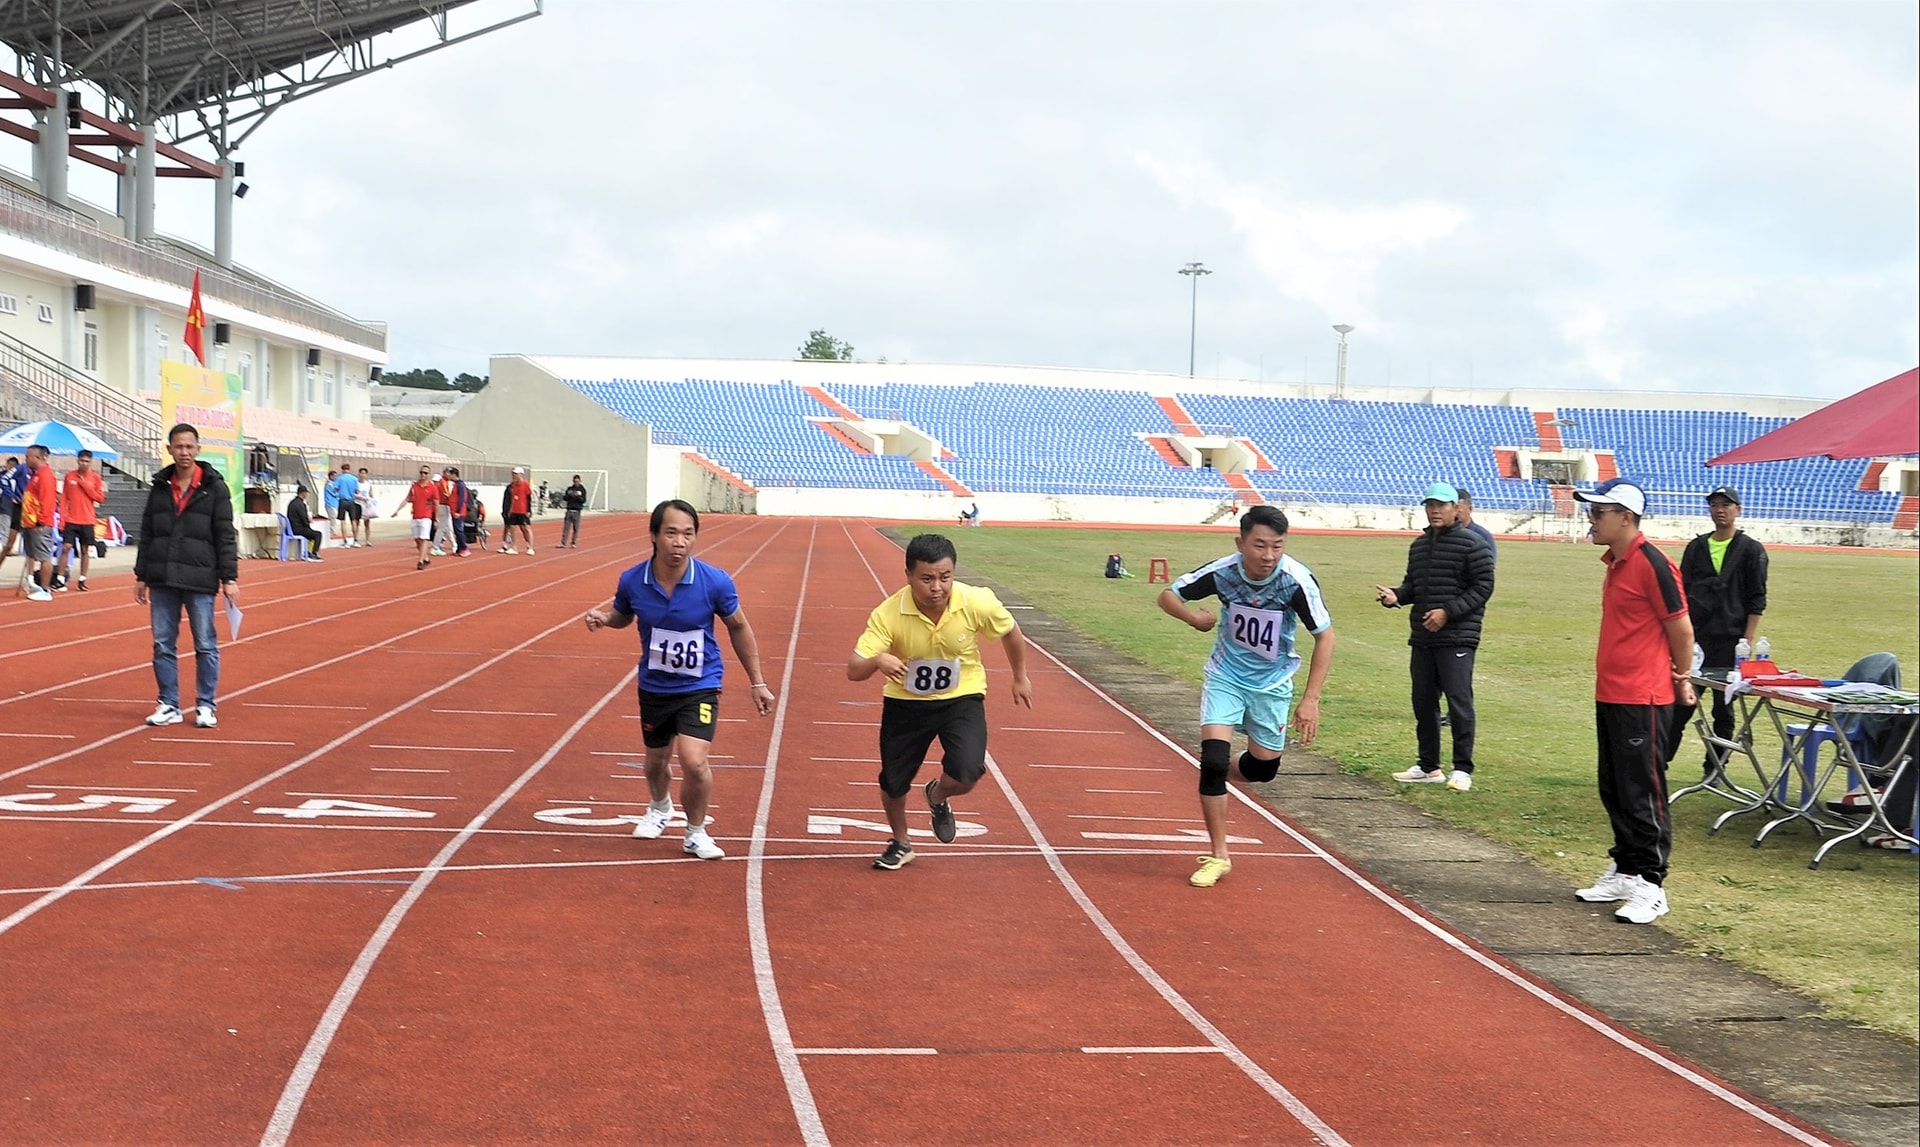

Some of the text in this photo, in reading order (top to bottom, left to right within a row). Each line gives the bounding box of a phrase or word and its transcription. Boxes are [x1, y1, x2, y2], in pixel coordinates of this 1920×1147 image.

[1234, 613, 1274, 652] 204
[659, 639, 698, 670] 136
[914, 665, 952, 691] 88
[699, 702, 712, 725] 5
[0, 793, 177, 814] 5
[252, 799, 437, 819] 4
[807, 815, 989, 837] 2
[1080, 828, 1264, 845] 1
